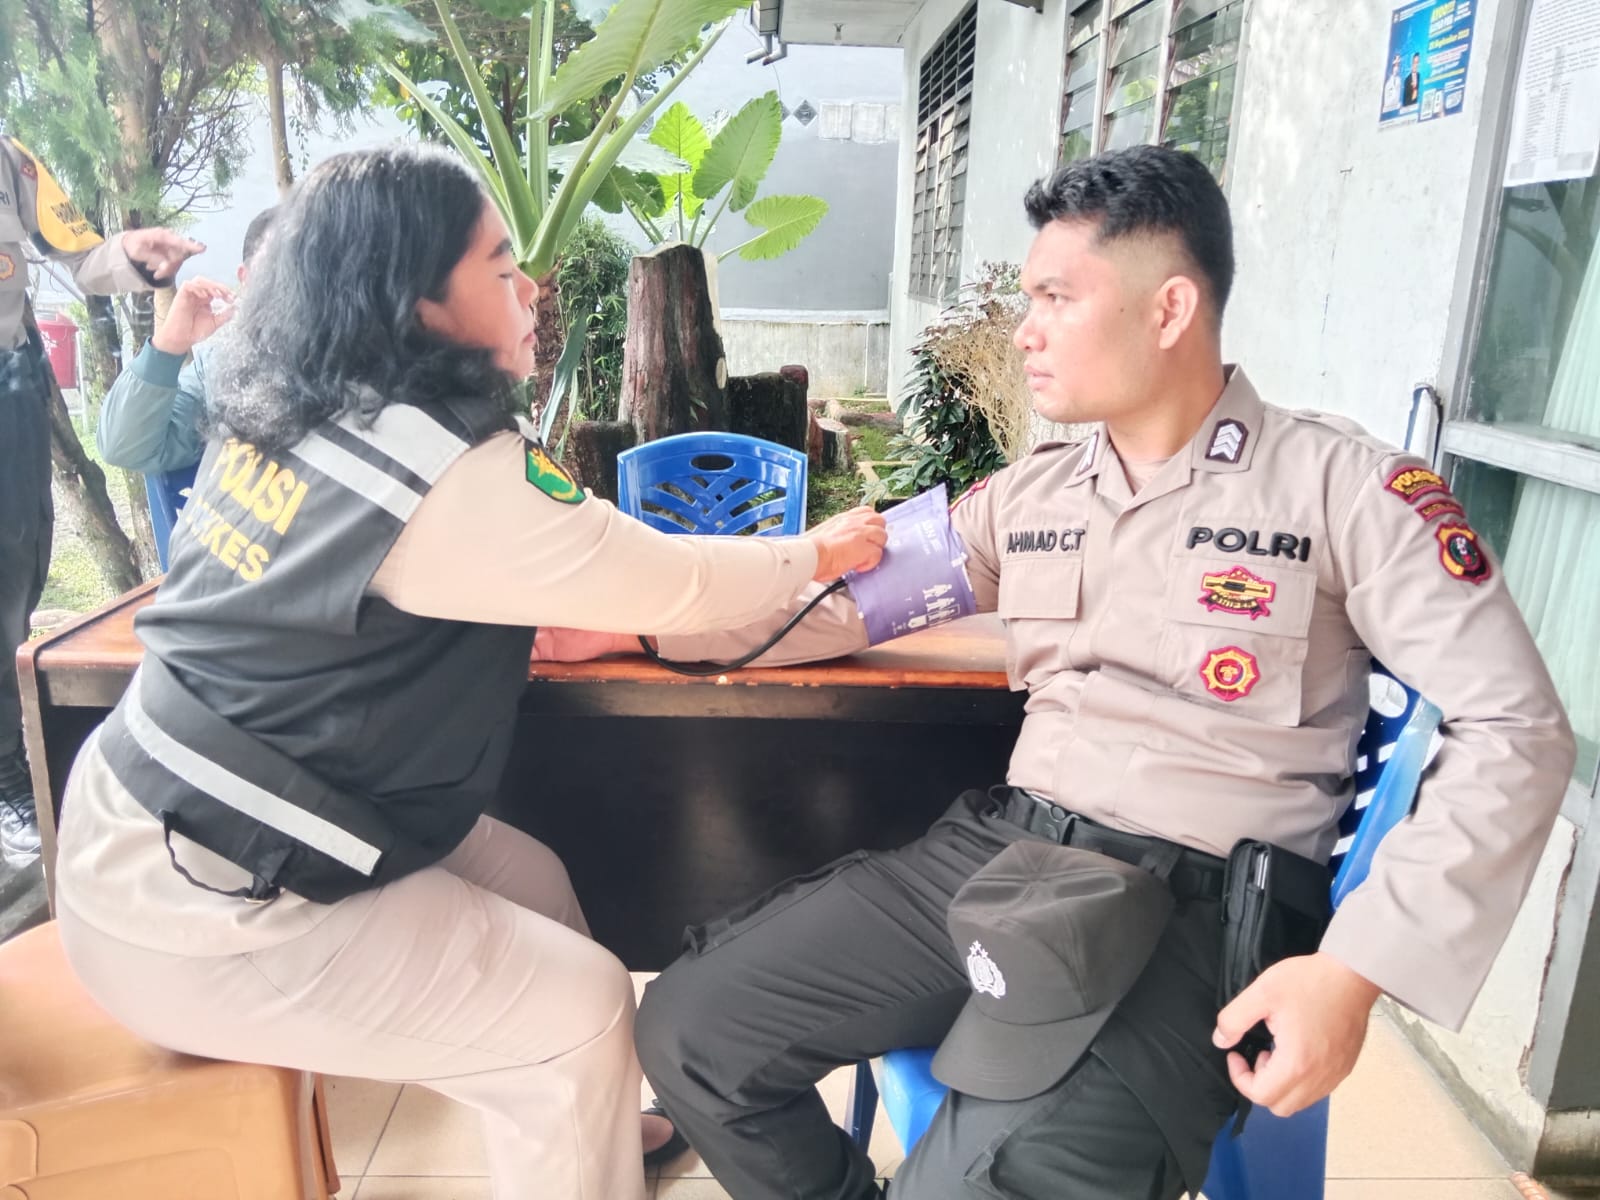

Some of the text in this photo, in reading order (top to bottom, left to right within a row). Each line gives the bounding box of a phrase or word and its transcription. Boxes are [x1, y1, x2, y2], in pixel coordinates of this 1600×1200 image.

[209, 437, 309, 536] POLISI
[1006, 528, 1086, 554] AHMAD C.T
[1186, 527, 1312, 562] POLRI
